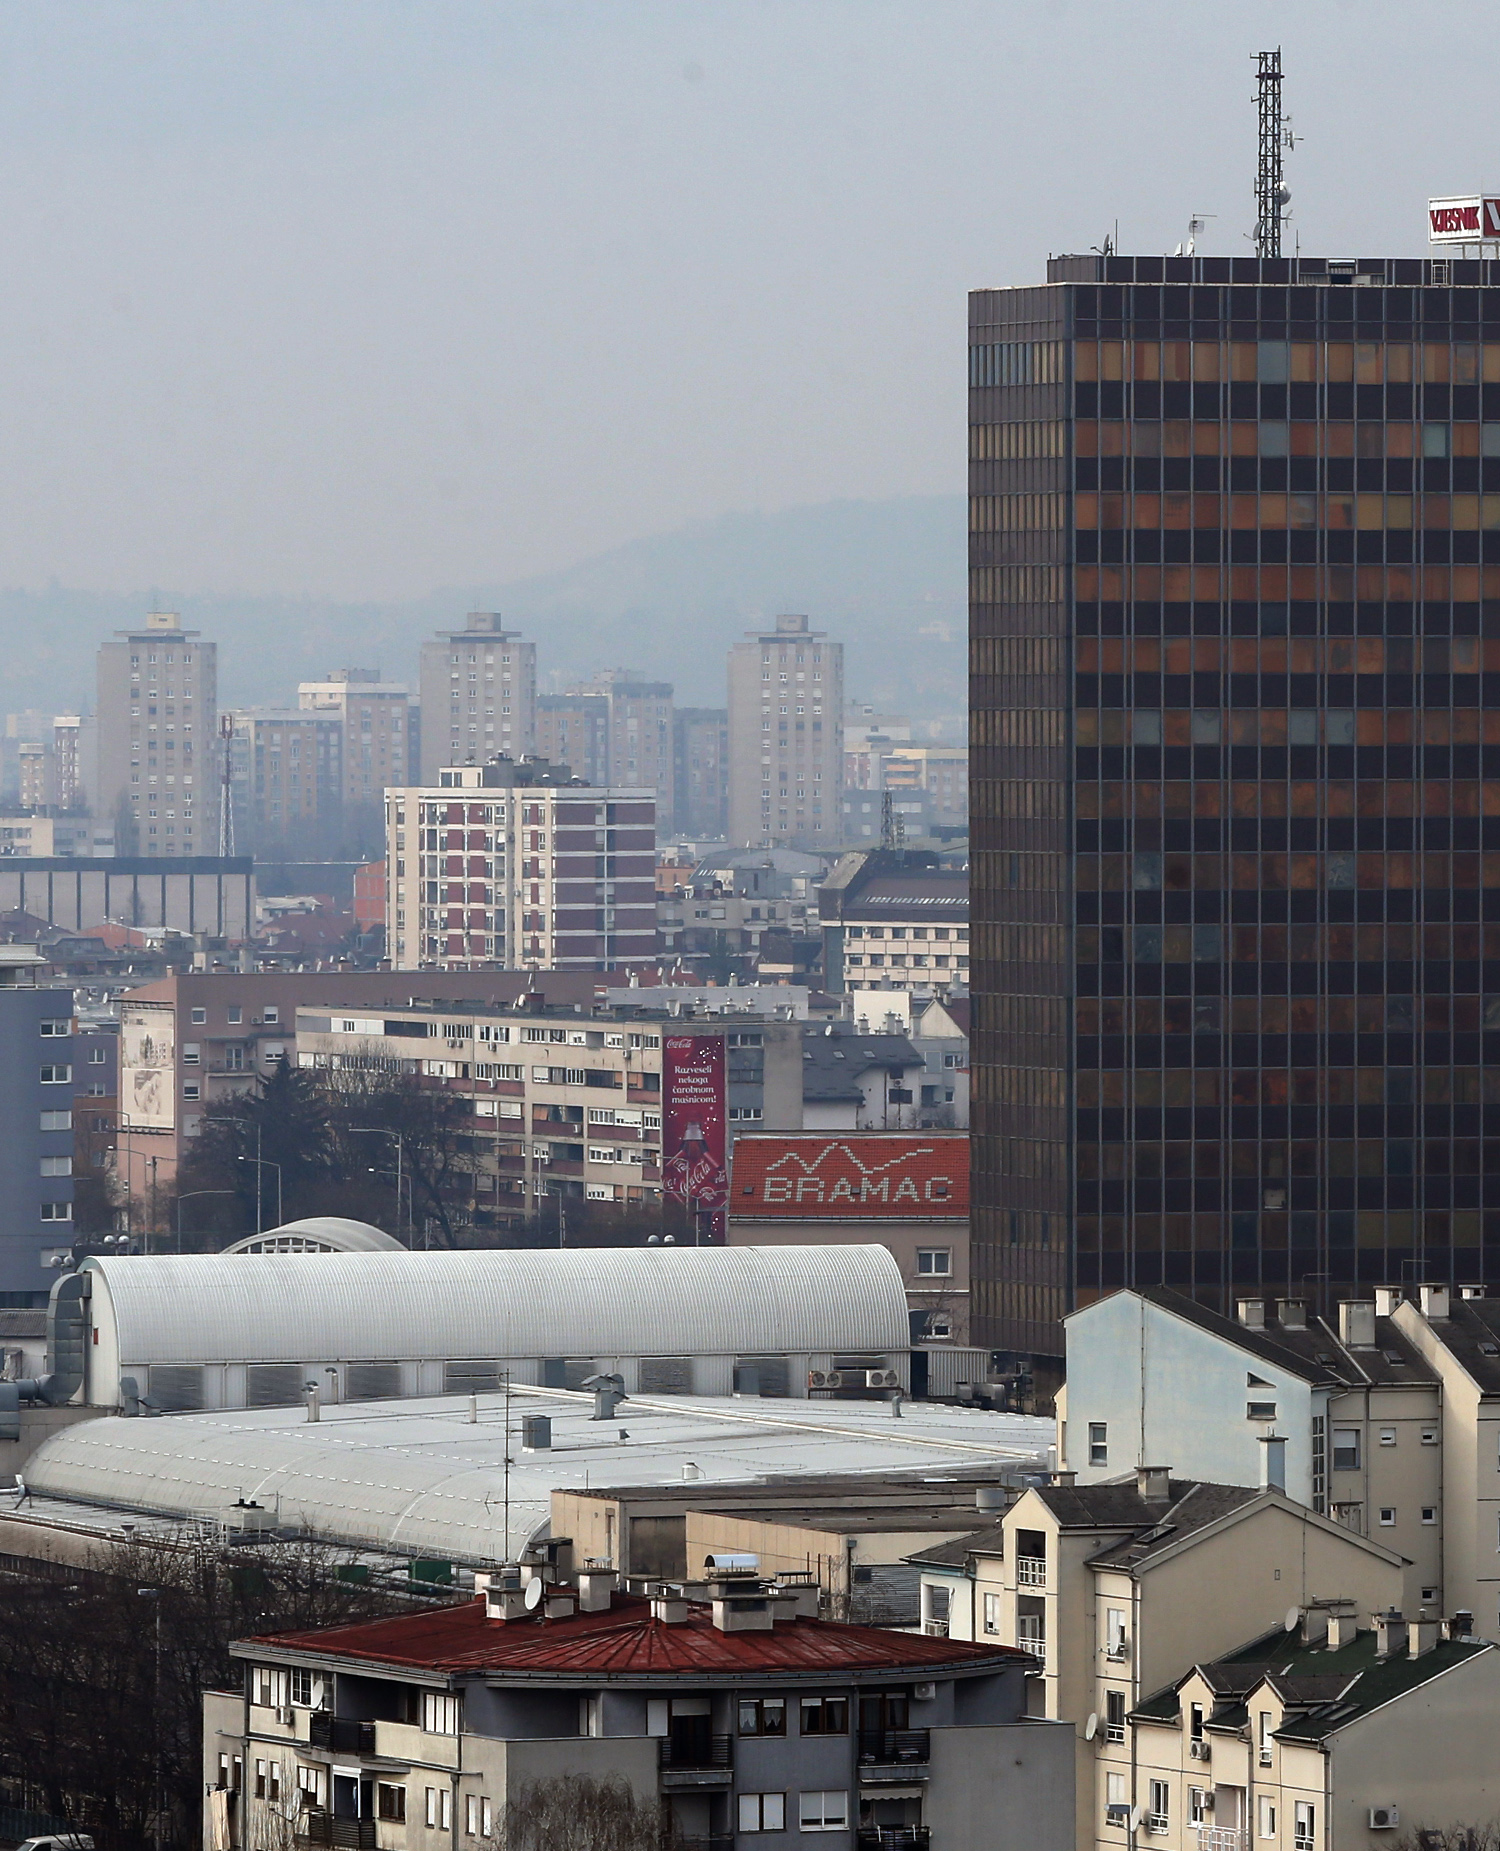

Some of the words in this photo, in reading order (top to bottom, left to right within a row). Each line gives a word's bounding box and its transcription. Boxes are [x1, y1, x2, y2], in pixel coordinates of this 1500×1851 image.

[674, 1065, 712, 1074] Razveseli
[678, 1076, 709, 1085] nekoga
[672, 1086, 714, 1094] čarobnom
[763, 1177, 953, 1202] BRAMAC
